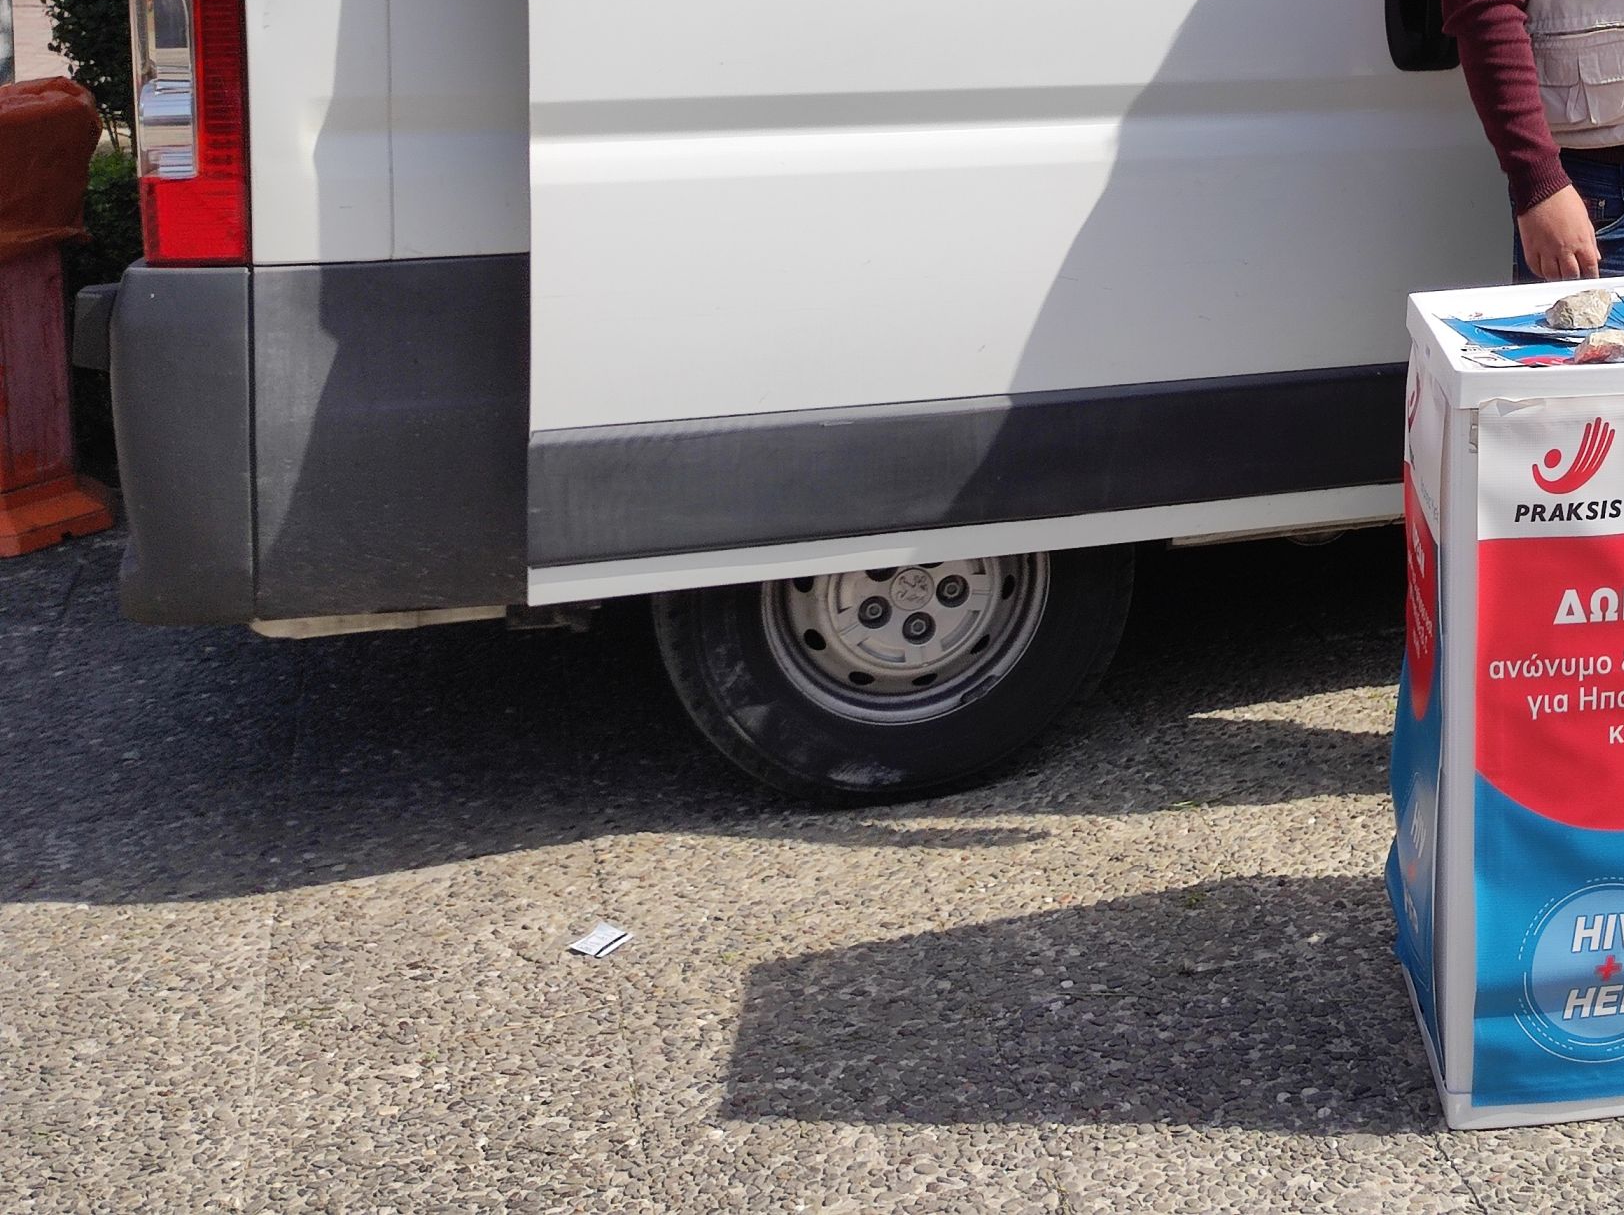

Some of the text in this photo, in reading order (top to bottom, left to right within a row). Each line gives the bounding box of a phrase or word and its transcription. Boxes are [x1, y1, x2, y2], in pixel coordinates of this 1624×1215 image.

[1514, 499, 1623, 523] PRAKSIS
[1489, 652, 1612, 681] ανώνυμο
[1527, 692, 1570, 720] για
